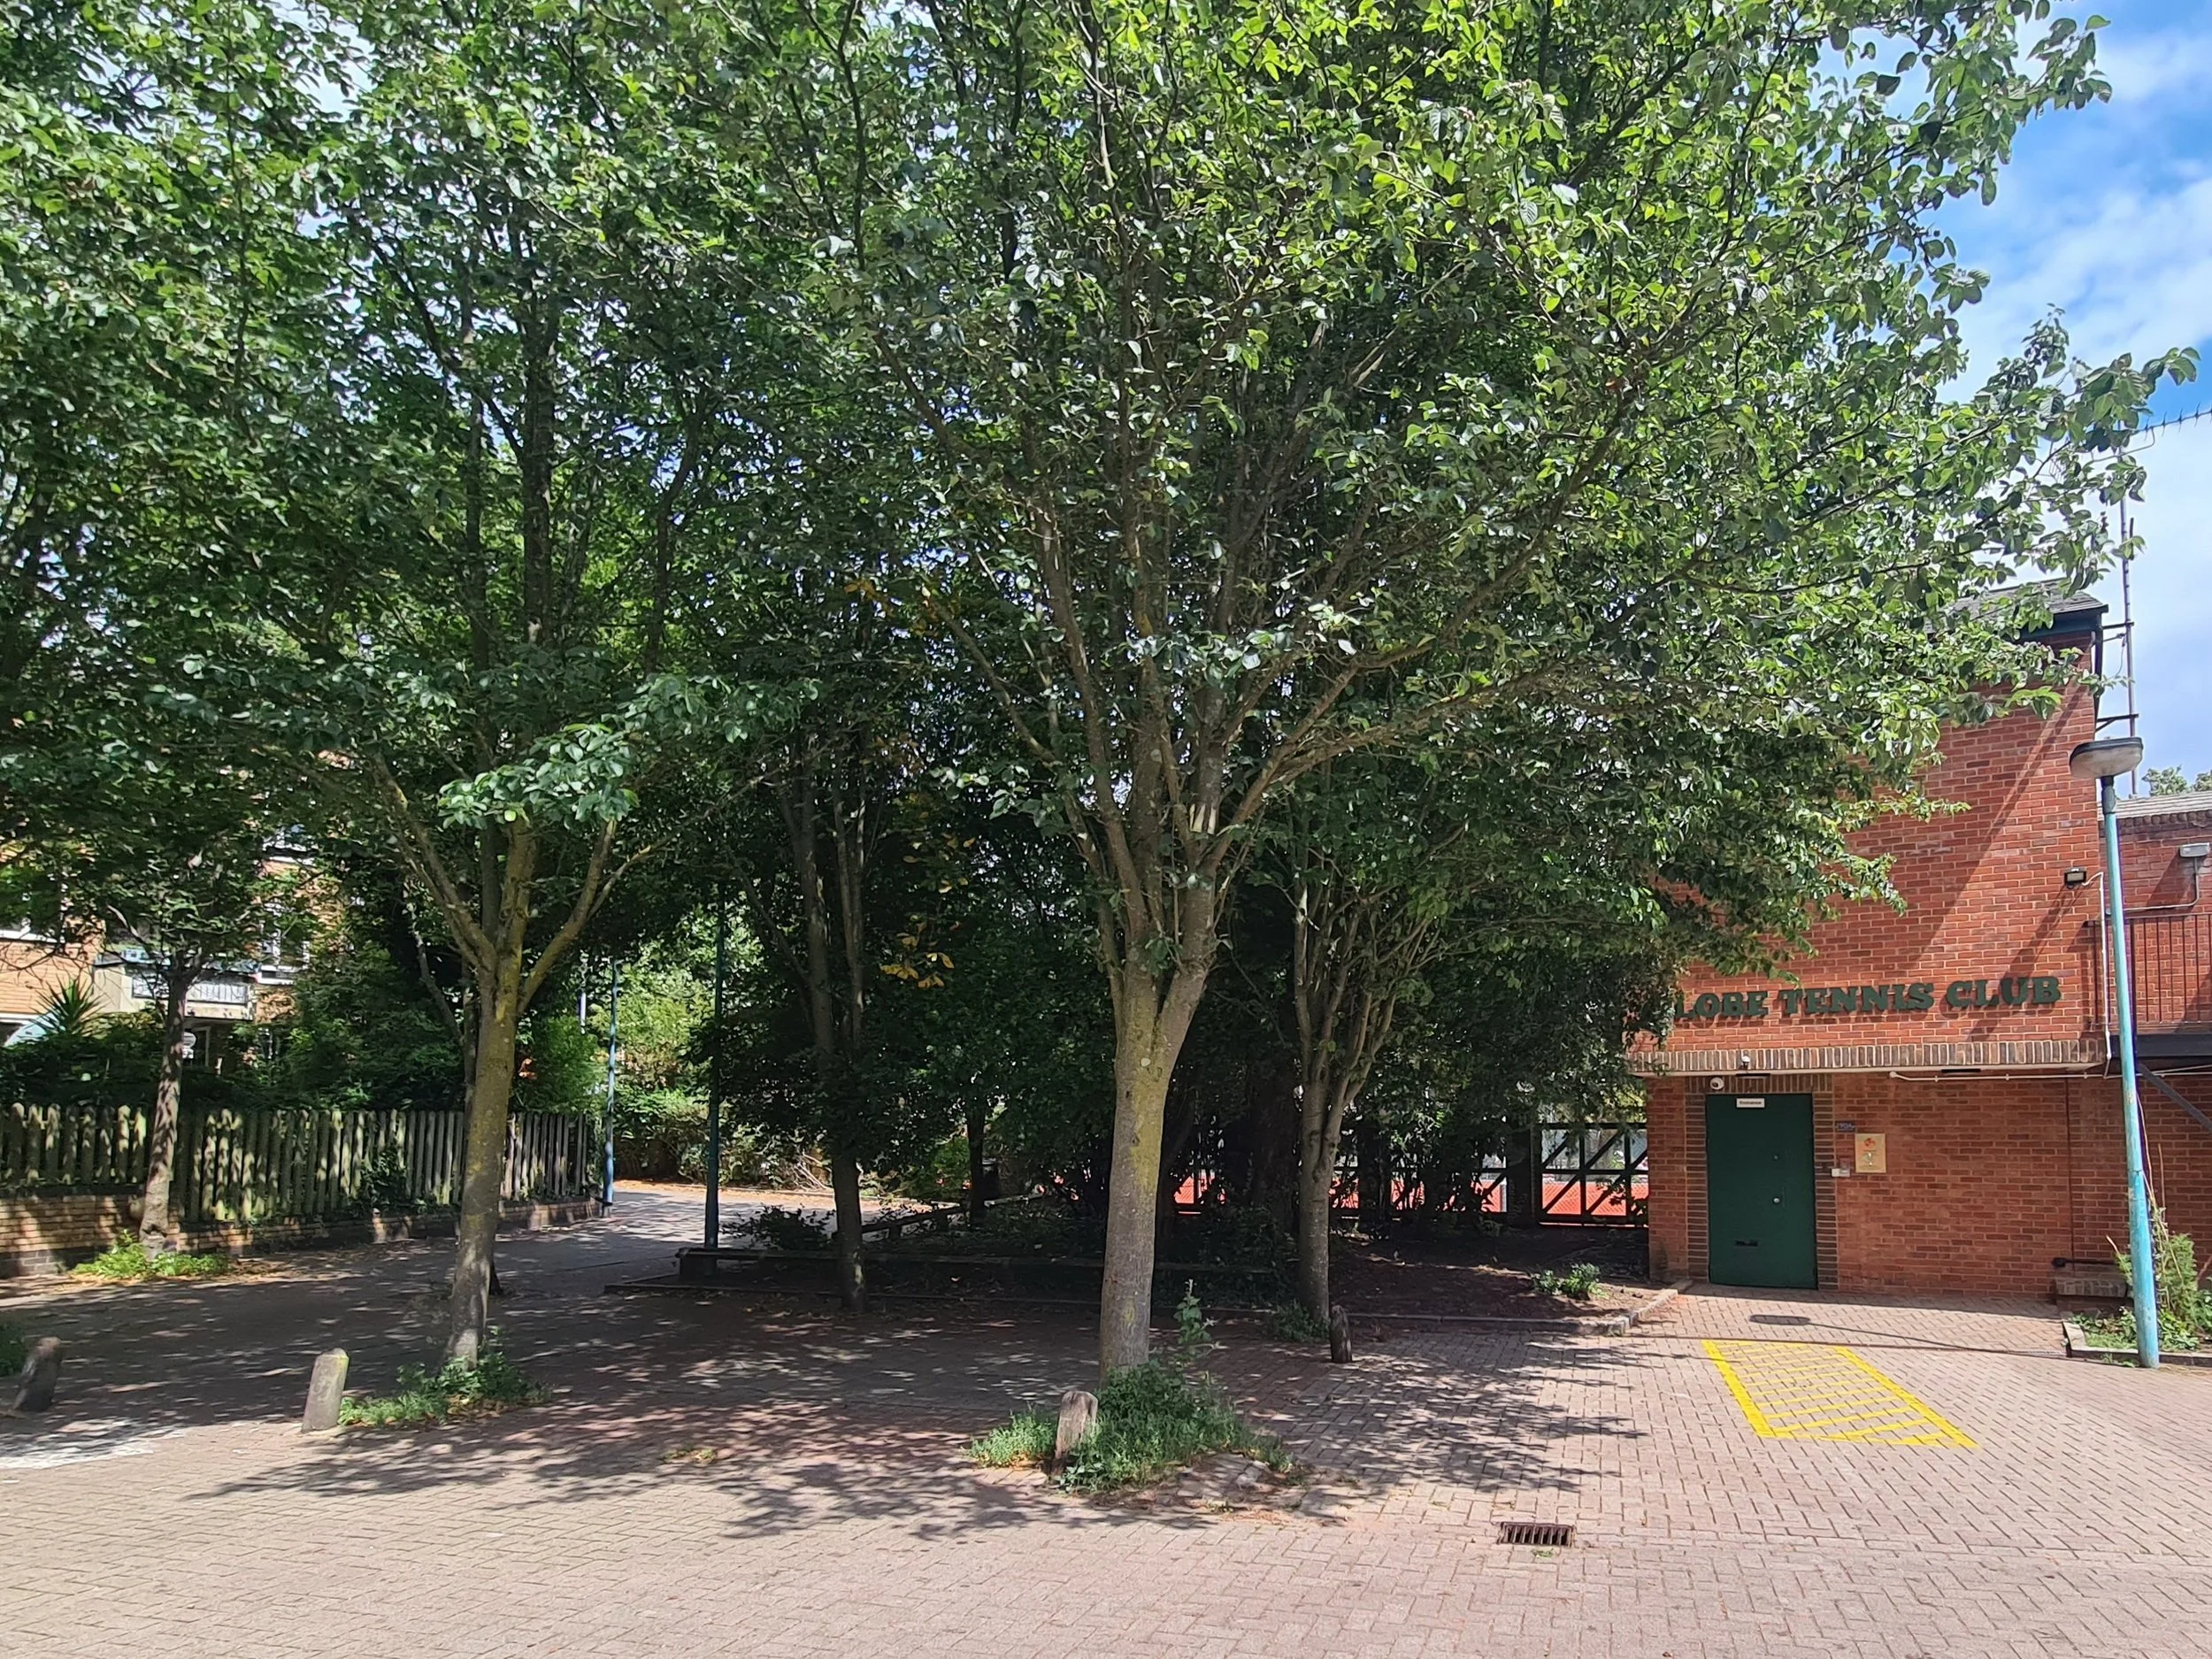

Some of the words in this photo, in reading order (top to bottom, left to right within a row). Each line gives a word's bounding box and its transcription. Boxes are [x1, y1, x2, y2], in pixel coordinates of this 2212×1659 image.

[1673, 990, 1769, 1018] LOBE
[1778, 983, 1935, 1014] TENNIS
[1946, 976, 2062, 1007] CLUB
